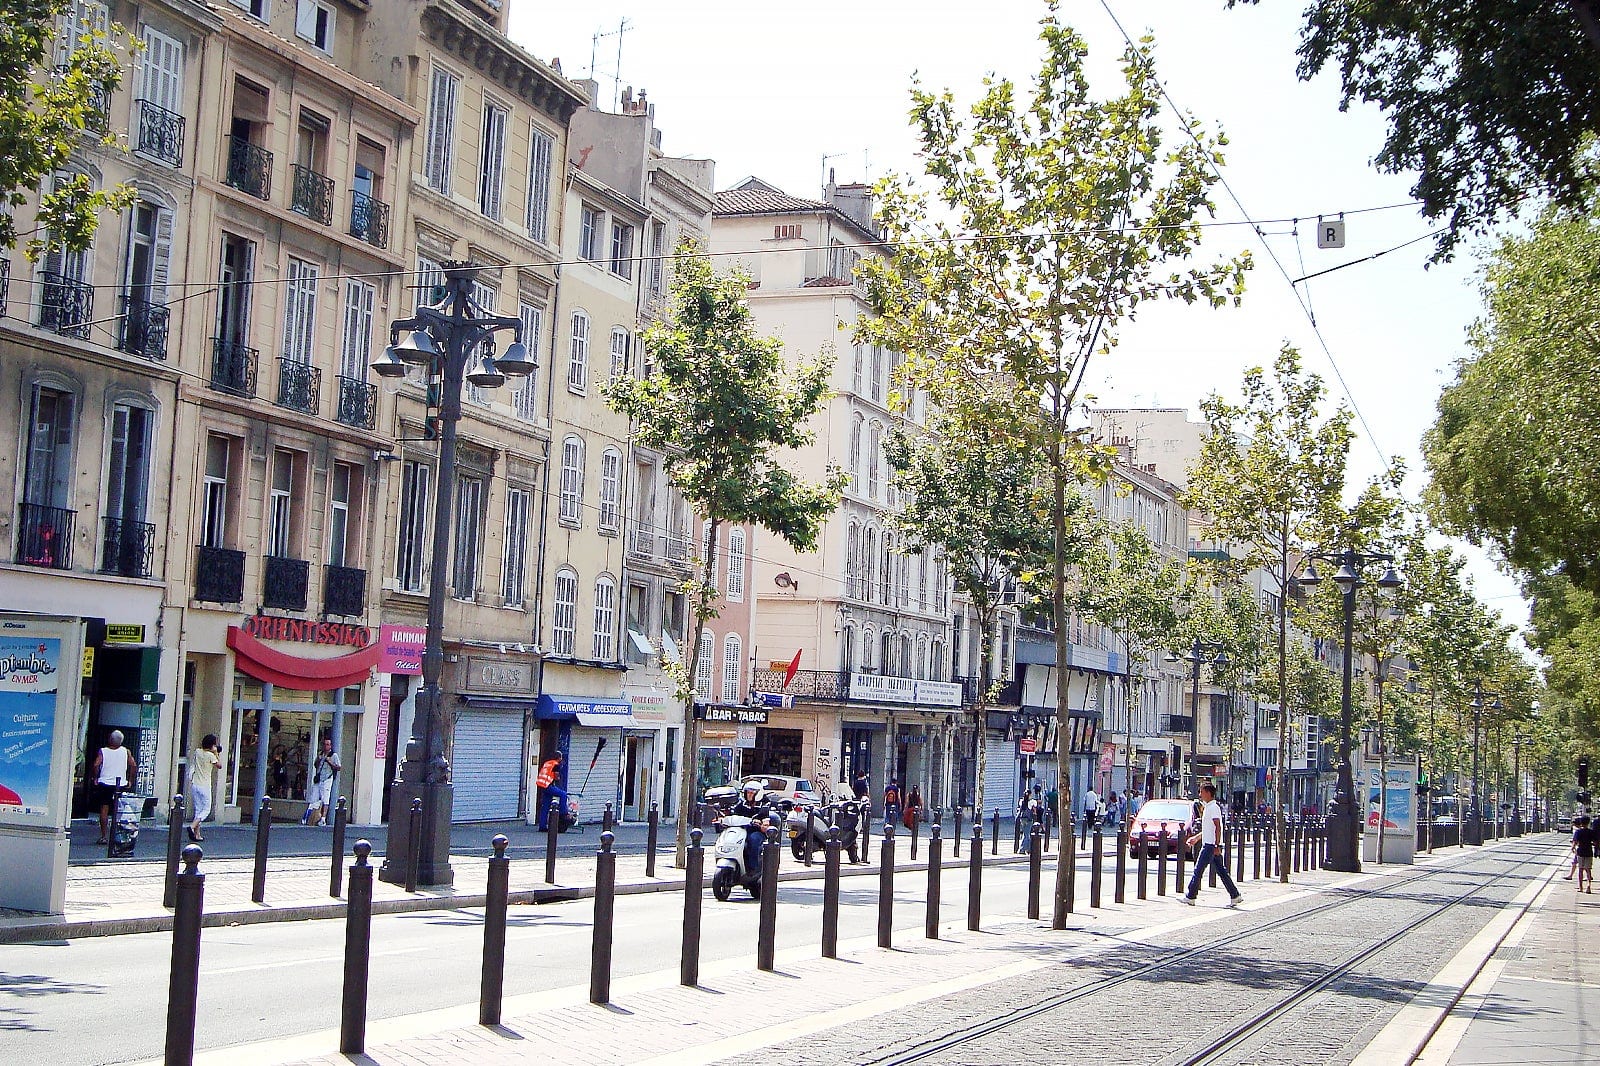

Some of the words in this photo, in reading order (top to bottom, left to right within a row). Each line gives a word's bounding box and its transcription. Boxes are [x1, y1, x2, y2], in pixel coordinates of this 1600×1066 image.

[1326, 227, 1337, 242] R
[243, 614, 371, 648] ORIENTISSIMO
[22, 675, 39, 684] MER
[482, 665, 522, 687] CLASS
[558, 703, 591, 713] TENDANCES
[592, 704, 629, 714] ACCESSOIRES
[13, 713, 38, 723] Culture
[712, 709, 732, 721] BAR
[737, 710, 767, 722] TABAC
